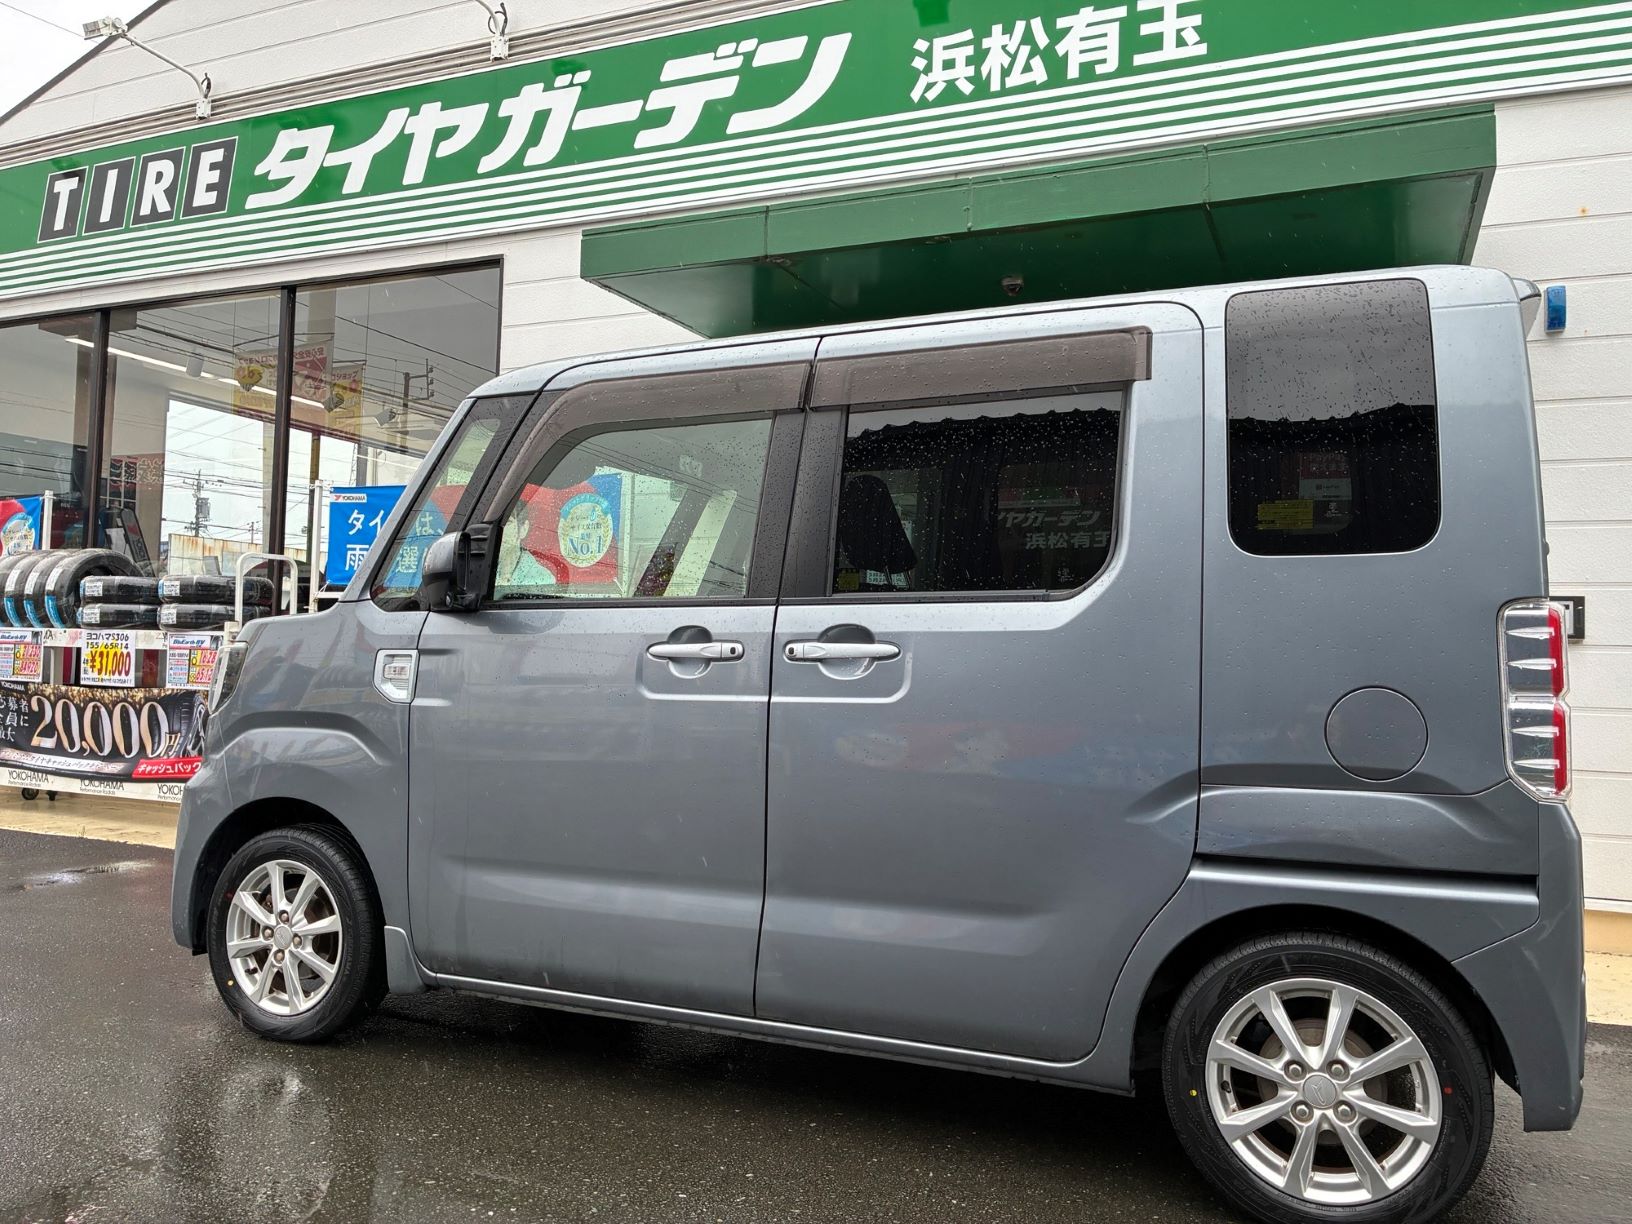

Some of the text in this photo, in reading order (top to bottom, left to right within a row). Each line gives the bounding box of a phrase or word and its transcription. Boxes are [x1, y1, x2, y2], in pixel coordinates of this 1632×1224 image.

[910, 0, 1208, 104] 浜松有玉
[52, 32, 852, 232] TIRE タイヤガーデン
[86, 632, 130, 642] ヨコハマS306
[86, 641, 129, 650] 155/65R14
[90, 650, 132, 677] ¥31,000
[138, 761, 202, 774] キャッシュバック
[8, 769, 49, 784] YOKOHAMA
[80, 779, 124, 791] YOKOHAMA
